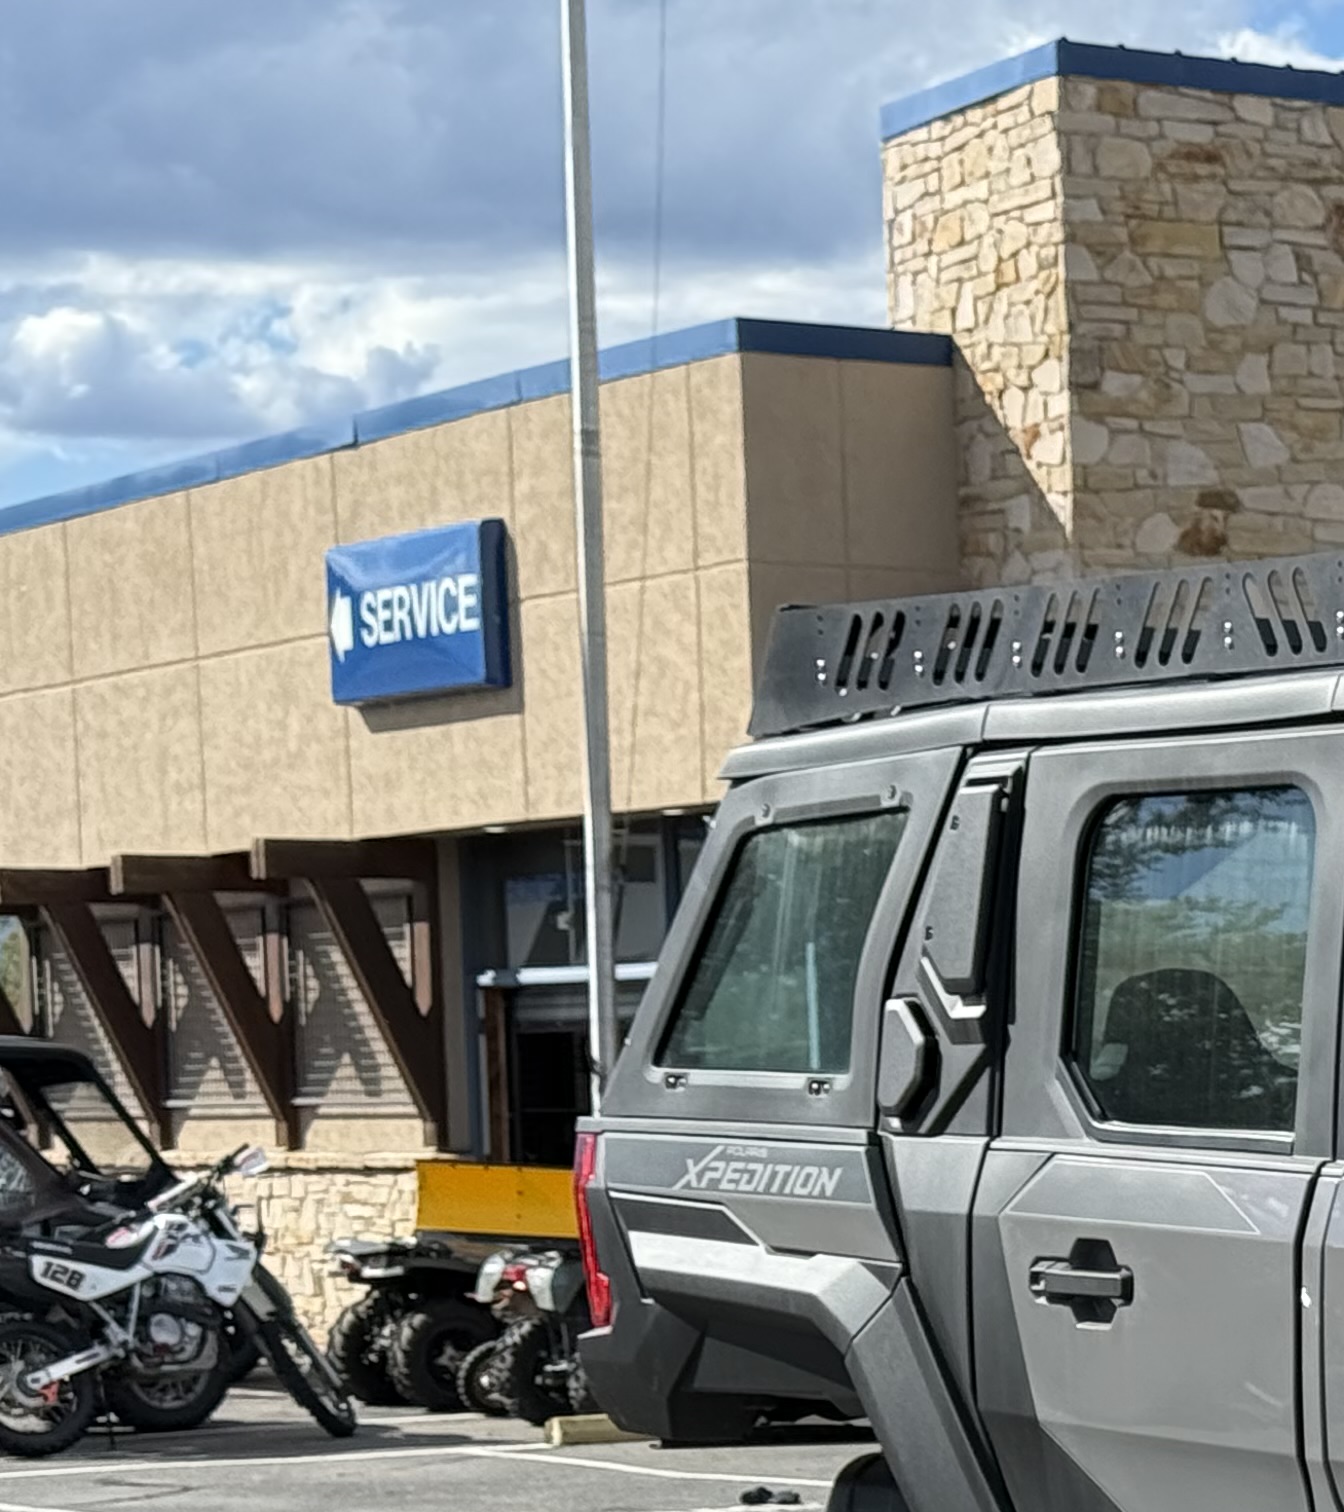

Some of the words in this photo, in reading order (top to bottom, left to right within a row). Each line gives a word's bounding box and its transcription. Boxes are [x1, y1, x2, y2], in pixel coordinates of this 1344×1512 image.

[359, 573, 480, 648] SERVICE
[672, 1145, 843, 1197] XPEDITION
[40, 1260, 87, 1291] 128
